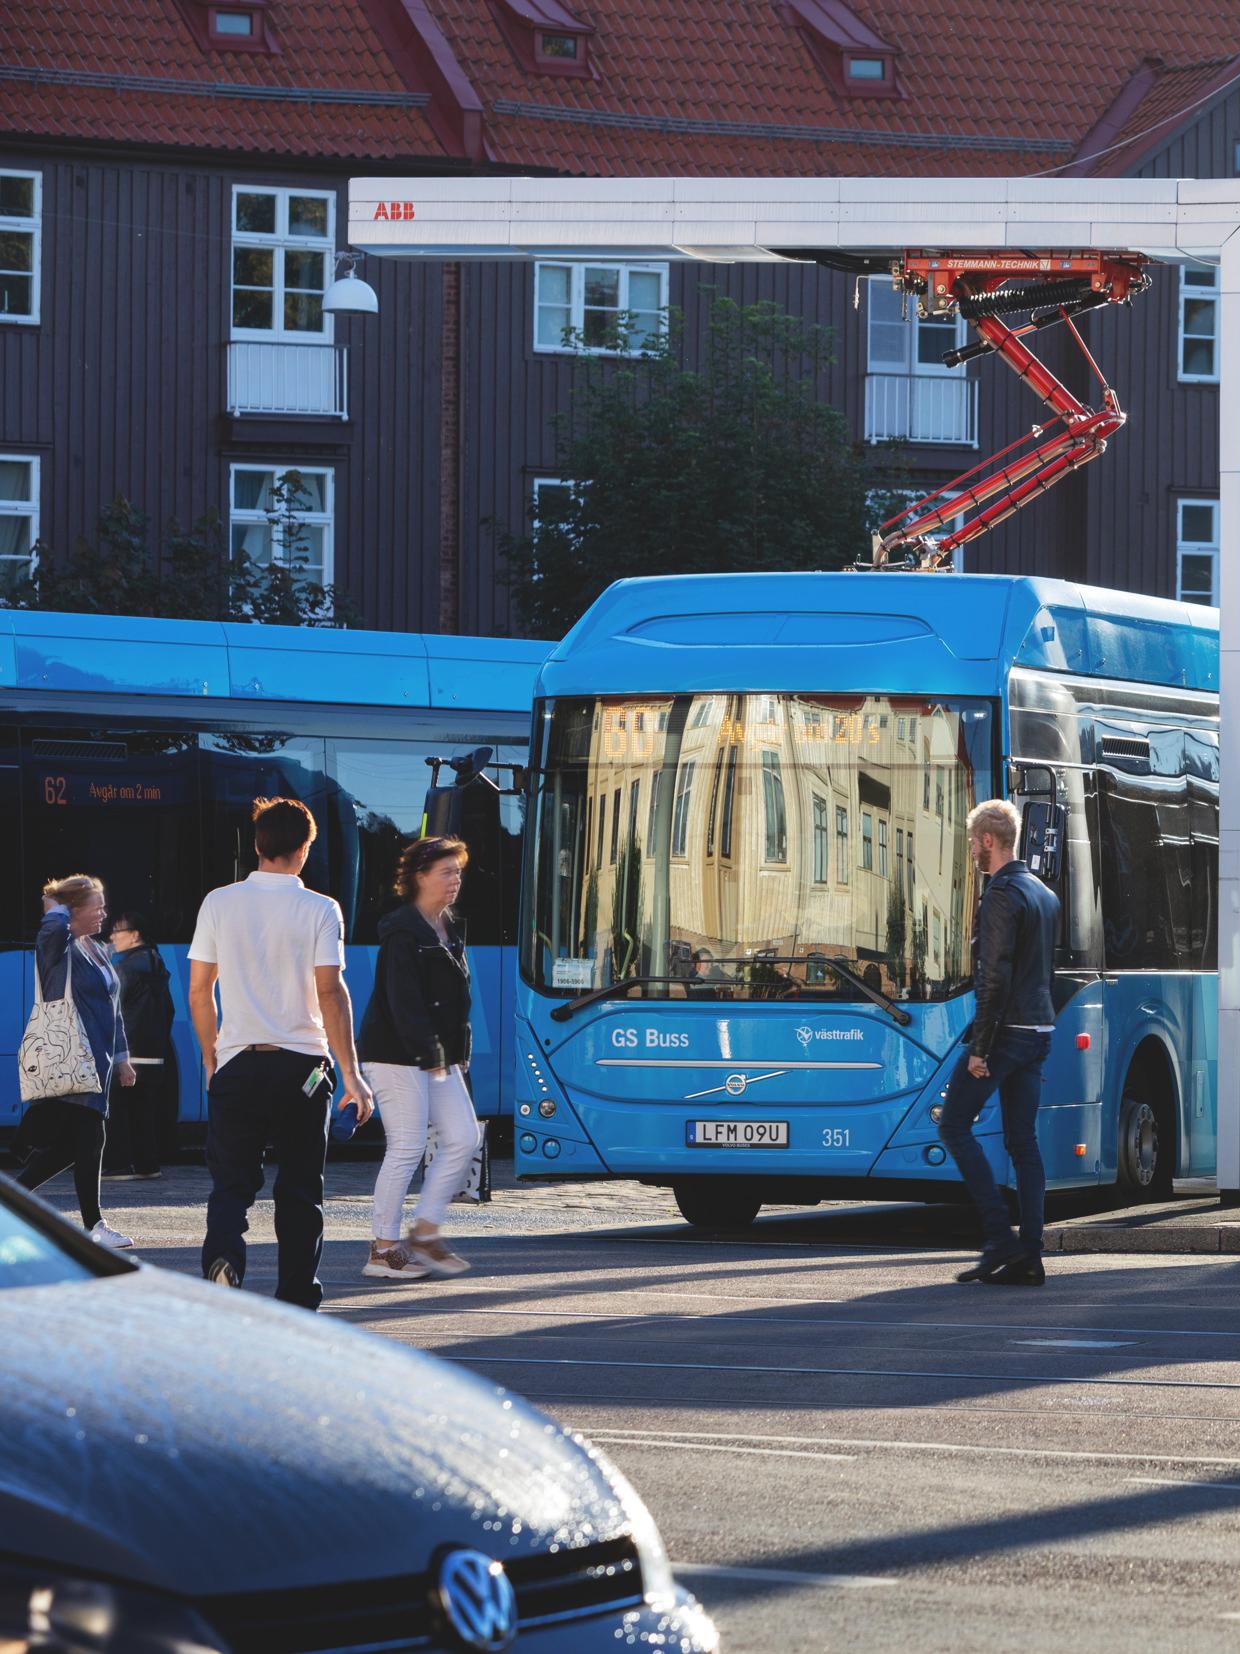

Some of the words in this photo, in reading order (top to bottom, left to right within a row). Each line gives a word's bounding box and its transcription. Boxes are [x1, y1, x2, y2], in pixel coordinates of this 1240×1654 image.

[373, 201, 415, 220] ABB
[946, 258, 1040, 269] STEMMANN-TECHNIK
[44, 776, 67, 804] 62
[89, 781, 117, 802] Avgår
[120, 786, 135, 799] om
[136, 783, 142, 800] 2
[144, 784, 161, 800] min
[611, 1029, 638, 1048] GS
[646, 1028, 689, 1048] Buss
[815, 1028, 864, 1041] västtrafik
[702, 1124, 738, 1142] LFM
[744, 1124, 780, 1142] 09U
[822, 1128, 850, 1147] 351
